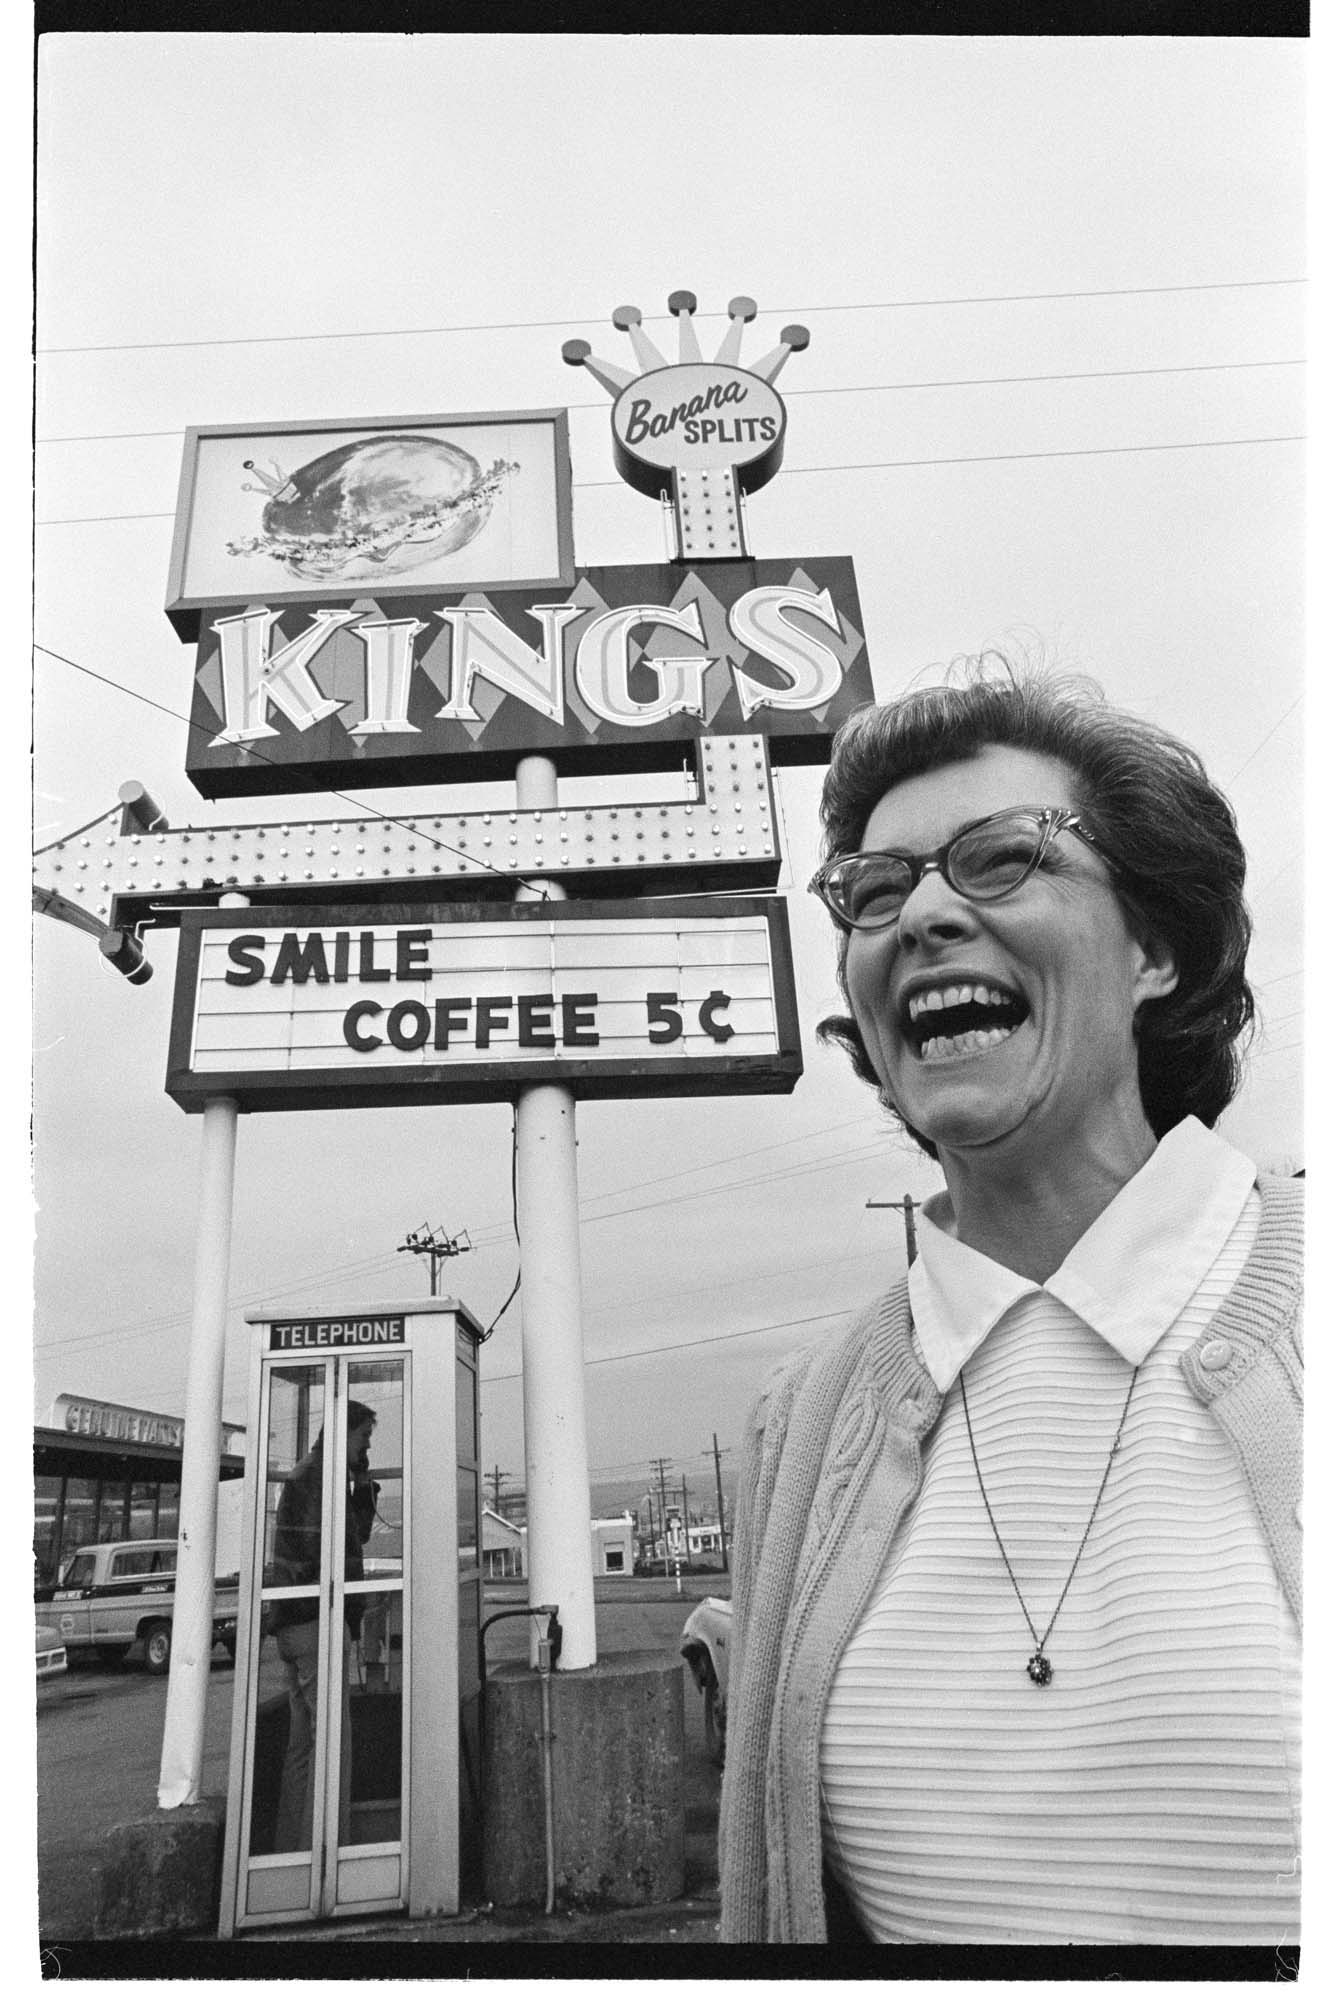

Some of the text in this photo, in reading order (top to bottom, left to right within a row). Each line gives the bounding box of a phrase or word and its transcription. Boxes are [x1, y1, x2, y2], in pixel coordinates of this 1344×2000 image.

[625, 381, 748, 445] Banana
[683, 416, 777, 444] SPLITS
[207, 586, 846, 747] KINGS
[225, 929, 433, 987] SMILE
[343, 993, 600, 1051] COFFEE
[276, 1320, 401, 1347] TELEPHONE
